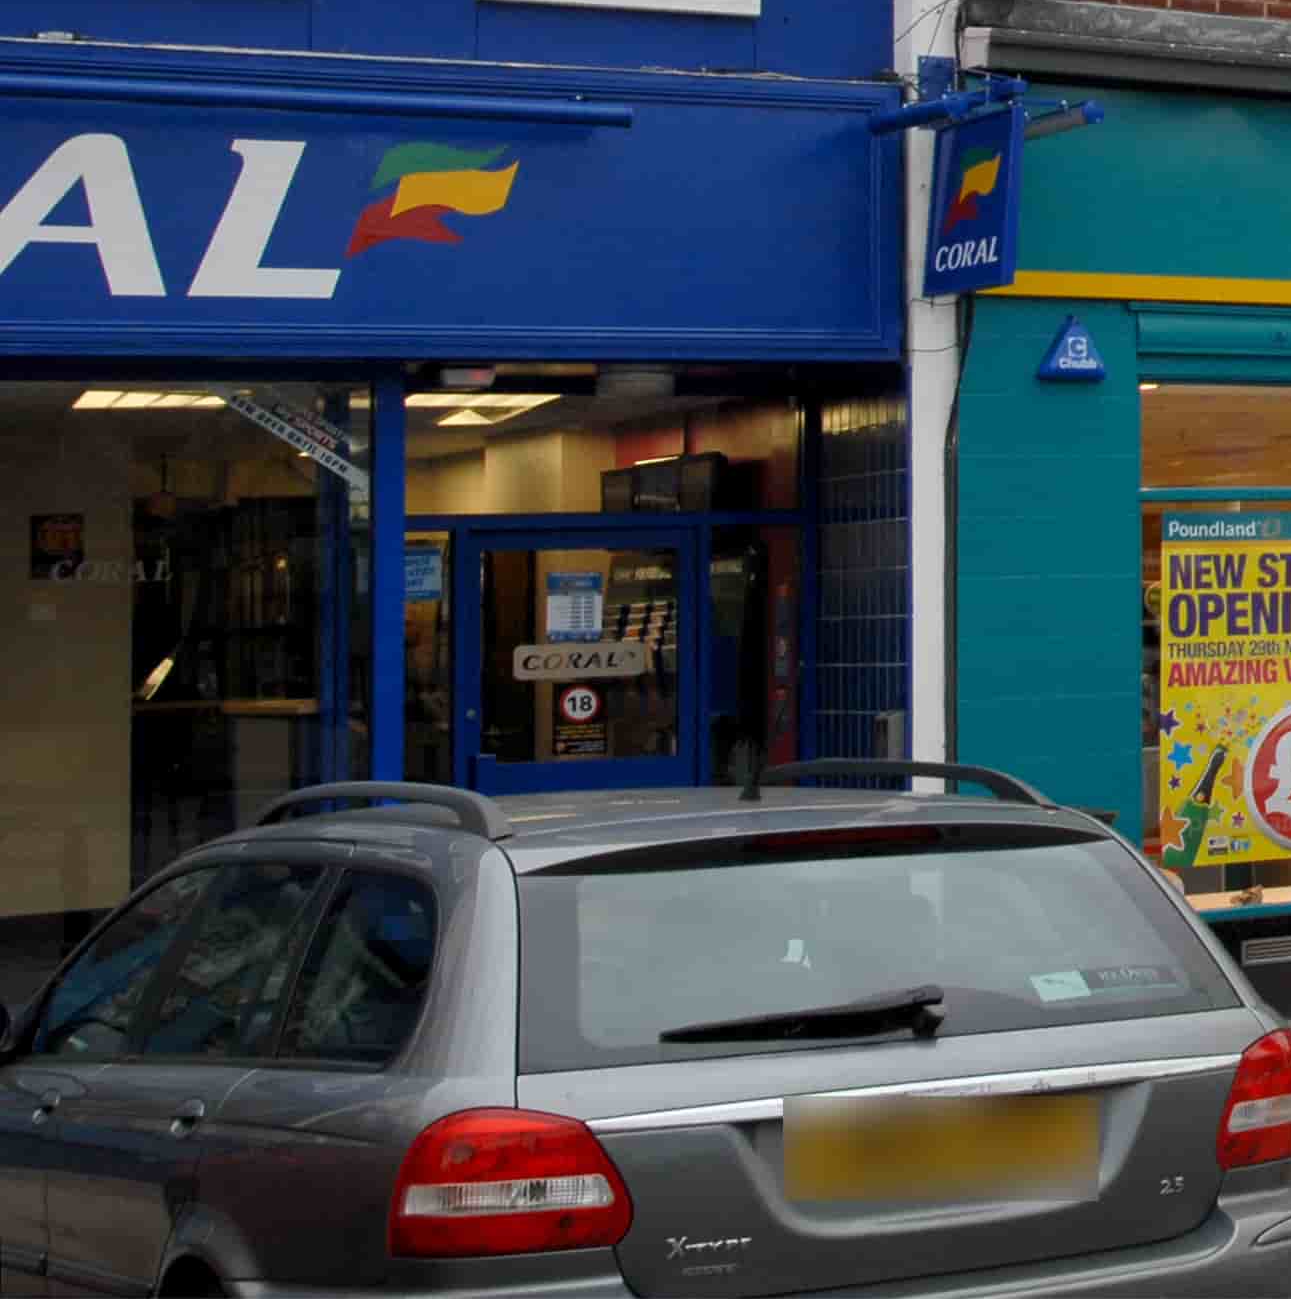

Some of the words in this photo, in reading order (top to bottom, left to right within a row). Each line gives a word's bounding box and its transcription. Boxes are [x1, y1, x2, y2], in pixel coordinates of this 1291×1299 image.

[935, 236, 998, 272] CORAL
[1168, 520, 1257, 537] Poundland
[1169, 554, 1247, 589] NEW
[1168, 642, 1246, 659] THURSDAY
[522, 652, 622, 672] CORAL
[1168, 659, 1279, 687] AMAZING
[567, 695, 593, 712] 18
